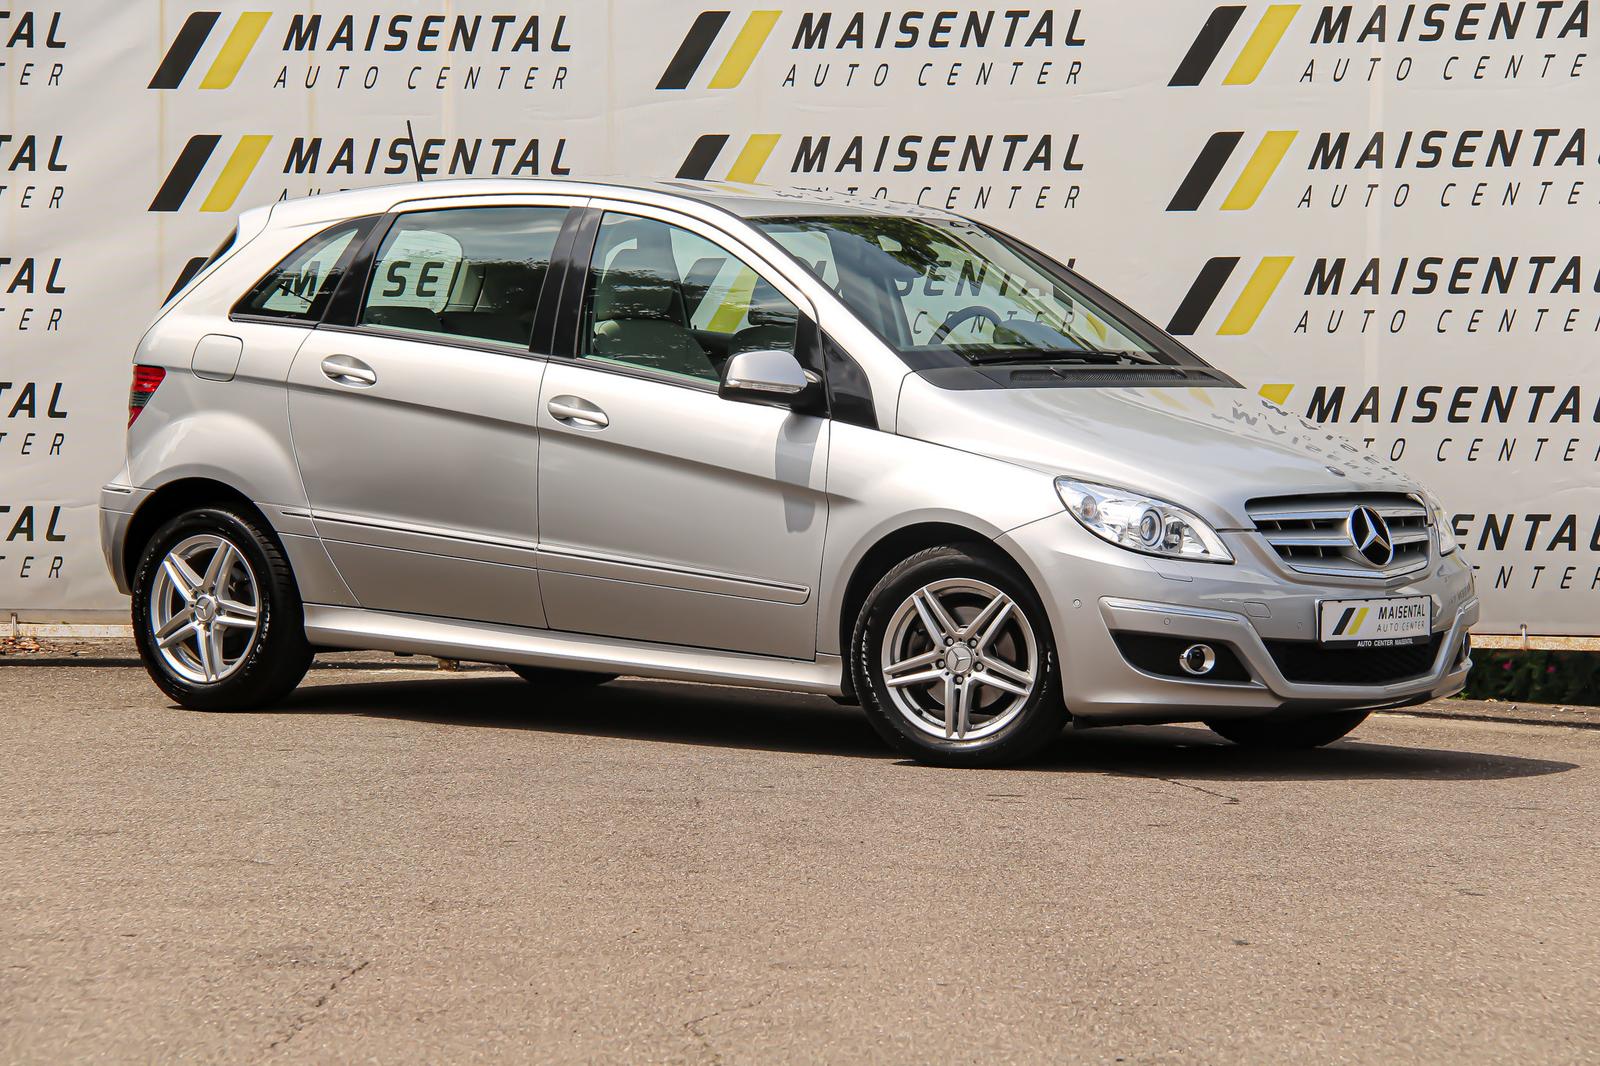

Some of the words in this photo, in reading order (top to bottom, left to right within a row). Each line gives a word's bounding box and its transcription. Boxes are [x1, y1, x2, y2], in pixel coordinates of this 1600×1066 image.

[283, 14, 571, 52] MAISENTAL
[791, 9, 1086, 49] MAISENTAL
[273, 66, 378, 89] AUTO
[407, 66, 568, 90] CENTER
[782, 64, 889, 87] AUTO
[918, 61, 1082, 87] CENTER
[1300, 57, 1413, 83] AUTO
[283, 138, 571, 175] MAISENTAL
[790, 134, 1084, 173] MAISENTAL
[1307, 128, 1600, 170] MAISENTA
[917, 185, 1080, 210] CENTER
[1298, 183, 1410, 208] AUTO
[1441, 182, 1600, 208] CENTE
[1294, 309, 1406, 333] AUTO
[1378, 604, 1426, 620] MAISENTAL
[1376, 623, 1399, 633] AUTO
[1401, 621, 1425, 632] CENTER
[1374, 639, 1394, 647] CENTER
